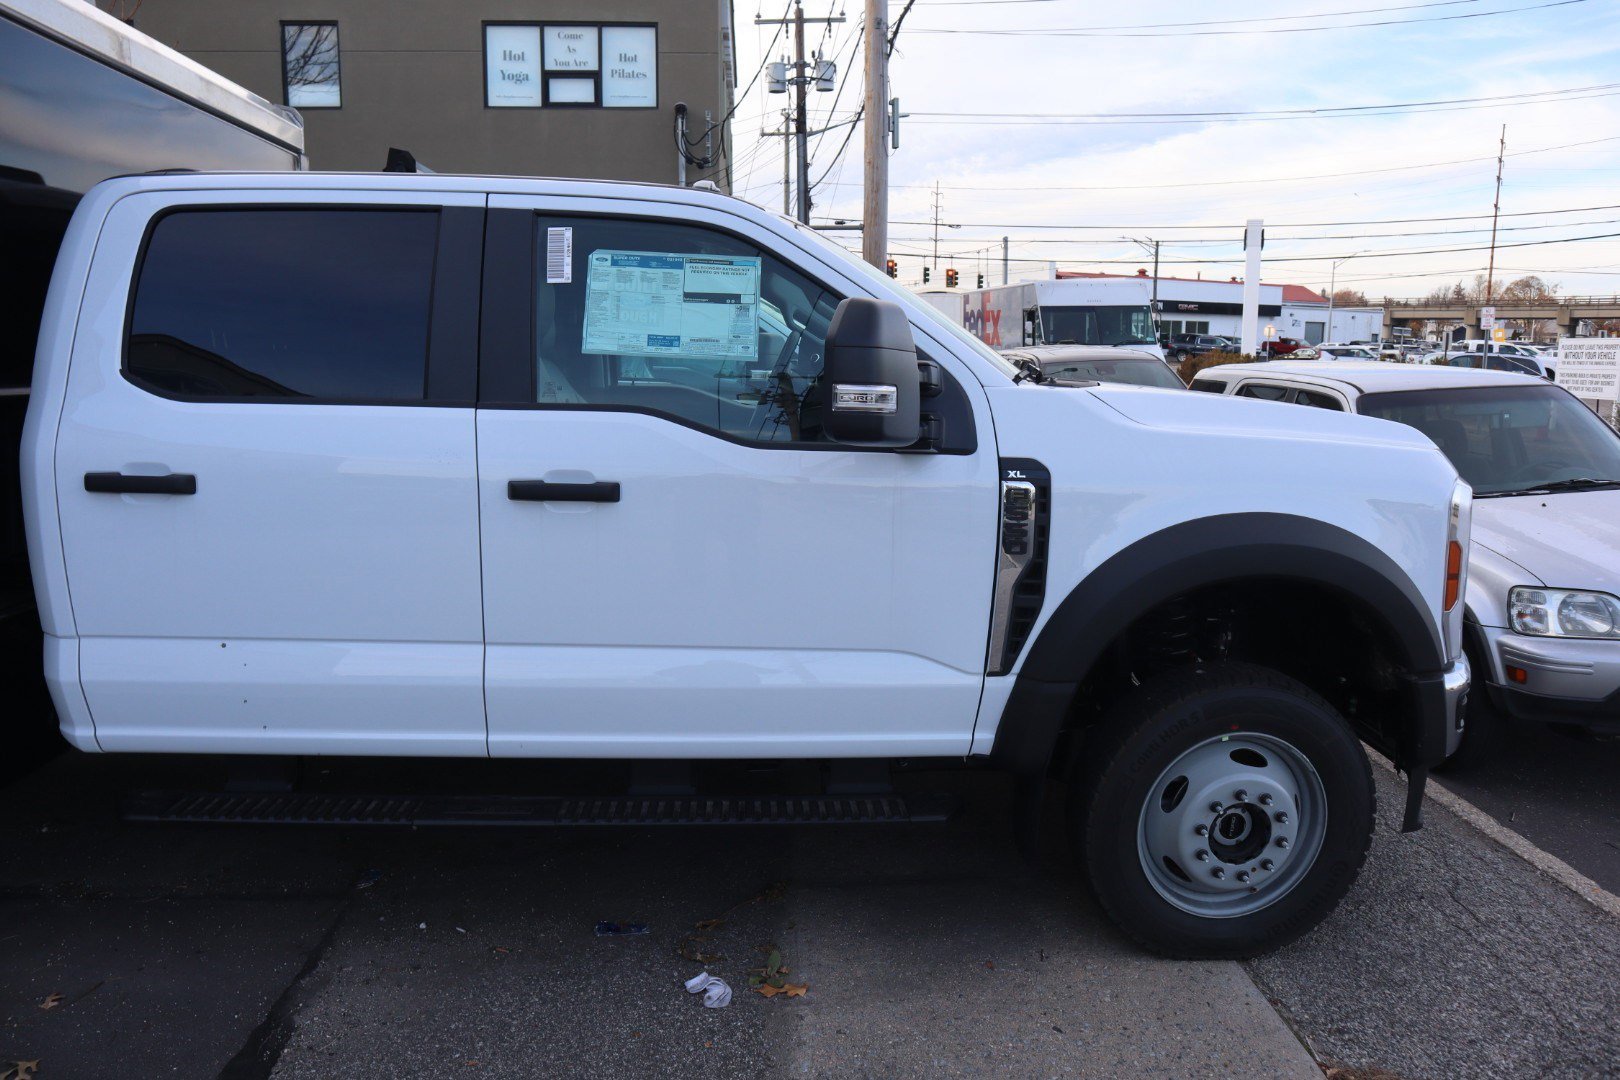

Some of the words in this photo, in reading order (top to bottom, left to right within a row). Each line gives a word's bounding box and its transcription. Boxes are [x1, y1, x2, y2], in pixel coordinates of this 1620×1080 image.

[557, 31, 584, 40] Come
[566, 44, 577, 54] As
[502, 50, 526, 62] Hot
[618, 53, 638, 63] Hot
[553, 58, 570, 68] You
[573, 58, 589, 68] Are
[499, 69, 530, 85] Yoga
[610, 68, 648, 79] Pilates
[1178, 303, 1199, 311] GMC
[963, 291, 1002, 346] FedEx
[1564, 351, 1584, 360] WITHOUT
[1585, 351, 1597, 360] YOUR
[1598, 351, 1617, 360] VEHICLE
[840, 394, 875, 402] FORD
[1007, 470, 1026, 478] XL
